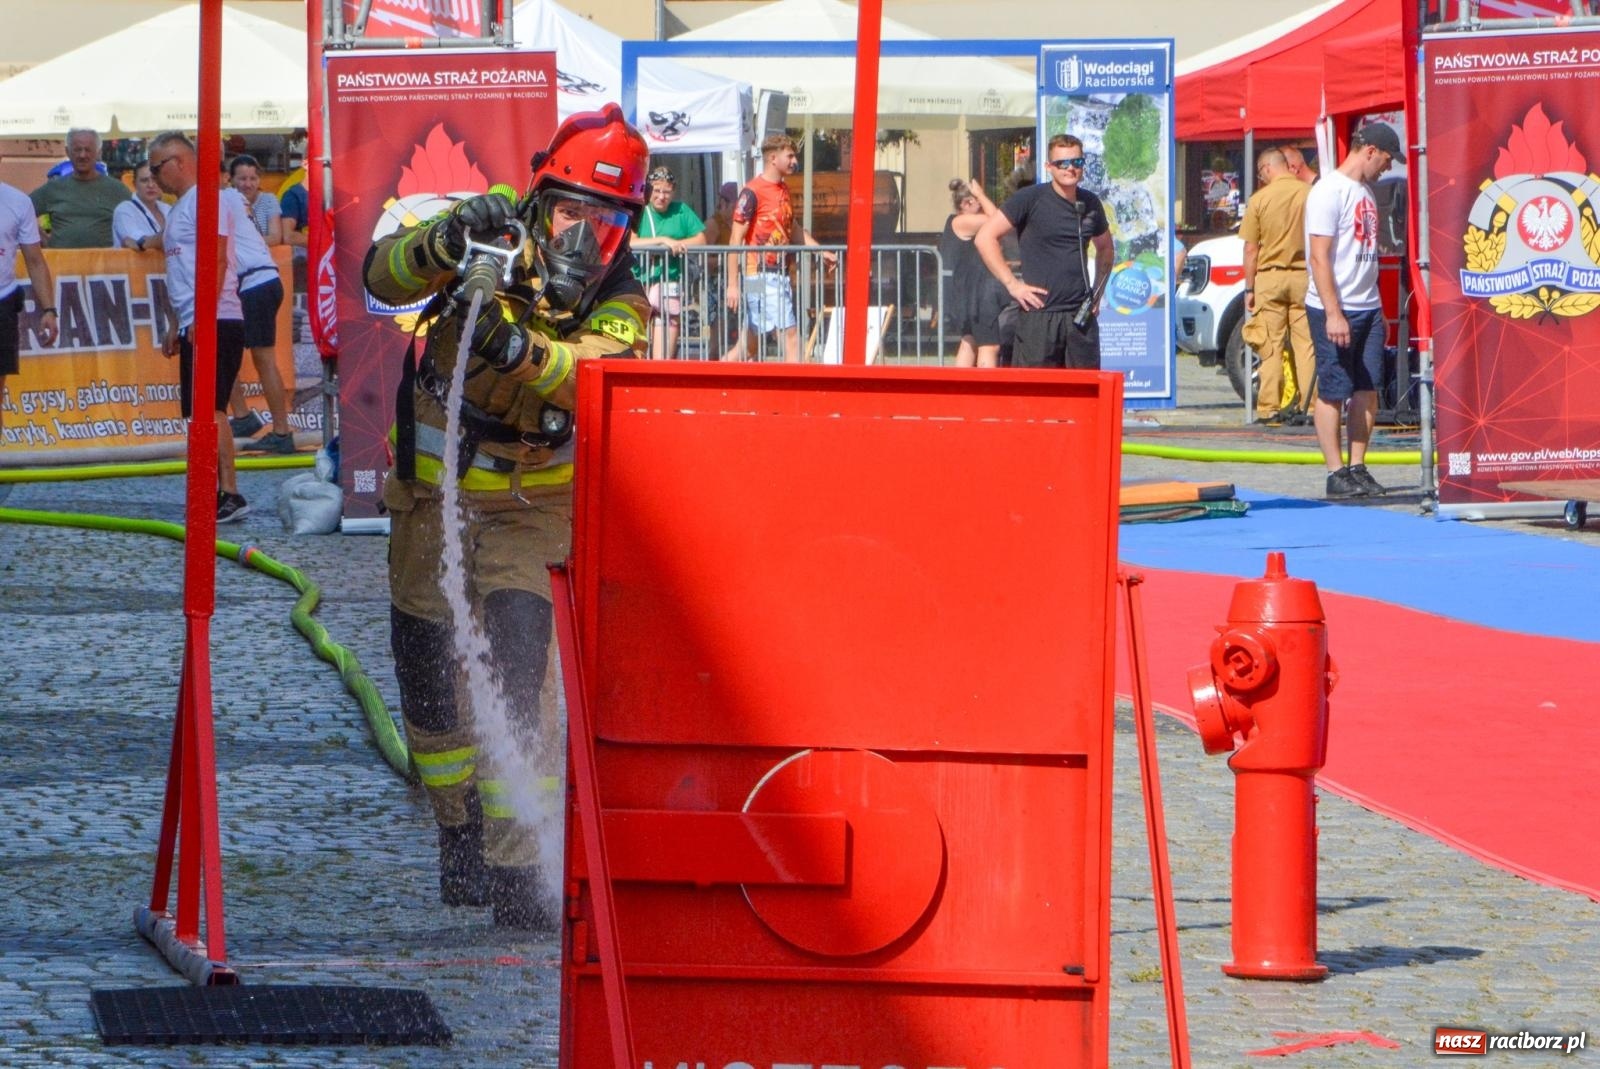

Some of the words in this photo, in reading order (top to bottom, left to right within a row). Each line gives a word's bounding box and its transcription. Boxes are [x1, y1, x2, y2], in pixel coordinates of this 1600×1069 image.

[1434, 52, 1530, 70] PAŃSTWOWA
[1532, 47, 1578, 65] STRAŻ
[337, 71, 432, 88] PAŃSTWOWA
[434, 68, 478, 85] STRAŻ
[481, 67, 547, 84] POŻARNA
[1083, 61, 1154, 77] Wodociągi
[1085, 74, 1155, 88] Raciborskie
[1434, 77, 1466, 85] KOMENDA
[1467, 75, 1505, 84] POWIATOWA
[1507, 73, 1549, 82] PAŃSTWOWEJ
[1550, 72, 1573, 80] STRAŻY
[338, 95, 369, 103] KOMENDA
[370, 94, 408, 102] POWIATOWA
[409, 93, 450, 102] PAŃSTWOWEJ
[451, 92, 474, 100] STRAŻY
[475, 91, 505, 100] POŻARNEJ
[513, 91, 548, 99] RACIBORZU
[1464, 270, 1530, 292] PAŃSTWOWA
[1533, 262, 1565, 281] STRAŻ
[598, 319, 630, 336] PSP
[77, 380, 144, 409] gabiony,
